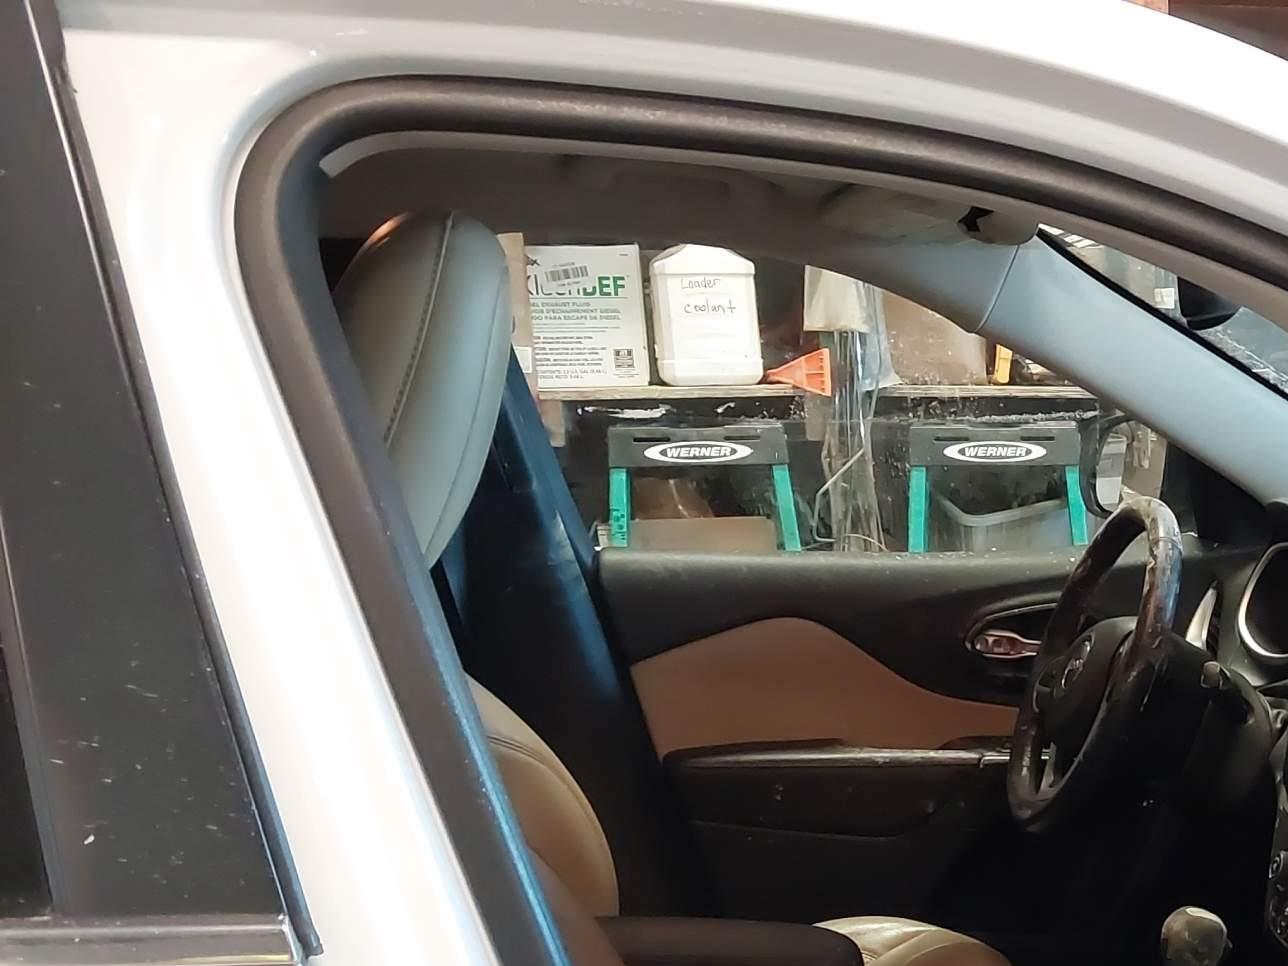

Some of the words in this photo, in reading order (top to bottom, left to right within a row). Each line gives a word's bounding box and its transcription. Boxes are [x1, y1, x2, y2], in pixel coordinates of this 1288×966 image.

[681, 276, 721, 290] Loader
[683, 296, 737, 314] coolant
[666, 447, 732, 457] WERNER
[964, 446, 1027, 457] WERNER
